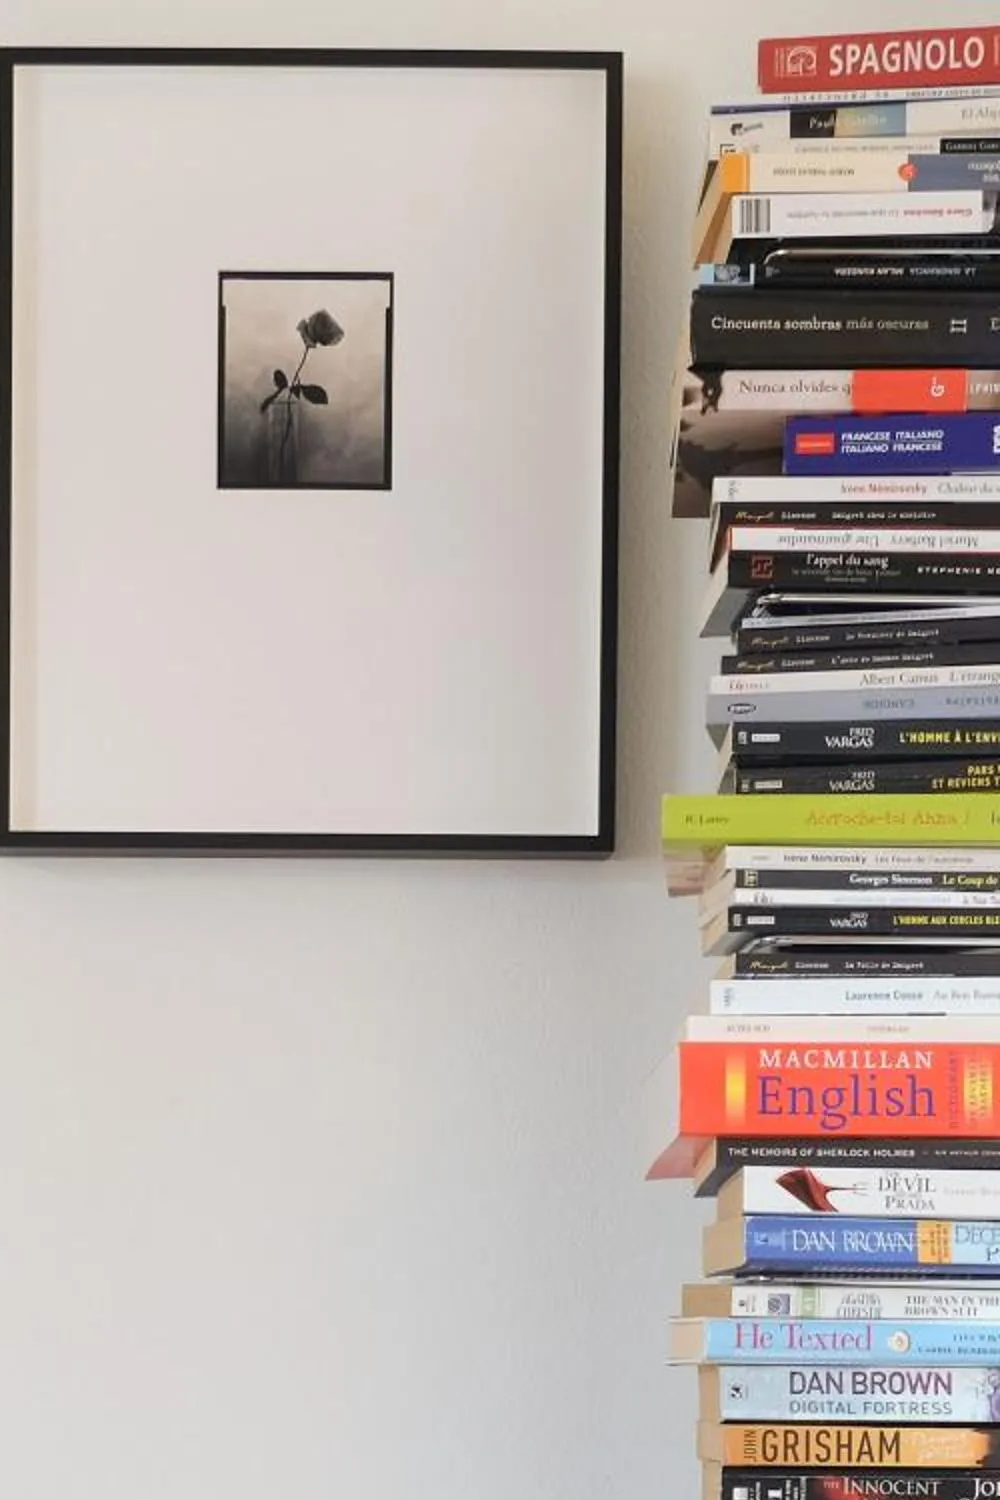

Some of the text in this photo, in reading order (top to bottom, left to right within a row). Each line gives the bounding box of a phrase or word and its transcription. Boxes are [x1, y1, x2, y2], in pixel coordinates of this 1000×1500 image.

[828, 36, 985, 77] SPAGNOLO
[711, 315, 929, 331] Cincuenta sombras más oscuras
[739, 380, 838, 394] Nunca olvides
[841, 430, 944, 441] FRANCESE ITALIANO
[841, 440, 942, 453] ITALIANO FRANCESE
[807, 553, 842, 567] l'appel
[846, 554, 861, 565] du
[859, 673, 895, 686] Albert
[825, 736, 874, 748] VARGAS
[900, 728, 963, 743] L'HOMME À
[967, 765, 993, 776] PARS
[829, 780, 875, 791] VARGAS
[932, 779, 945, 789] ET
[849, 874, 888, 886] Georges
[892, 874, 933, 885] Simenon
[942, 875, 955, 885] Le
[958, 874, 984, 887] Coup
[759, 1049, 933, 1069] MACMILLAN
[758, 1074, 936, 1131] English
[728, 1148, 915, 1158] THE MEMOIRS OF SHERLOCK HOLMES
[878, 1175, 936, 1193] DEVIL
[885, 1198, 935, 1211] PRADA
[792, 1229, 836, 1252] DAN
[843, 1230, 915, 1253] BROWN
[905, 1295, 929, 1305] THE
[935, 1295, 958, 1305] MAN
[961, 1295, 972, 1305] IN
[904, 1305, 948, 1315] BROWN
[735, 1322, 873, 1351] He Texted
[789, 1371, 952, 1396] DAN BROWN
[789, 1401, 953, 1415] DIGITAL FORTRESS
[744, 1430, 756, 1462] JOHN
[762, 1429, 900, 1463] GRISHAM
[844, 1477, 942, 1497] INNOCENT
